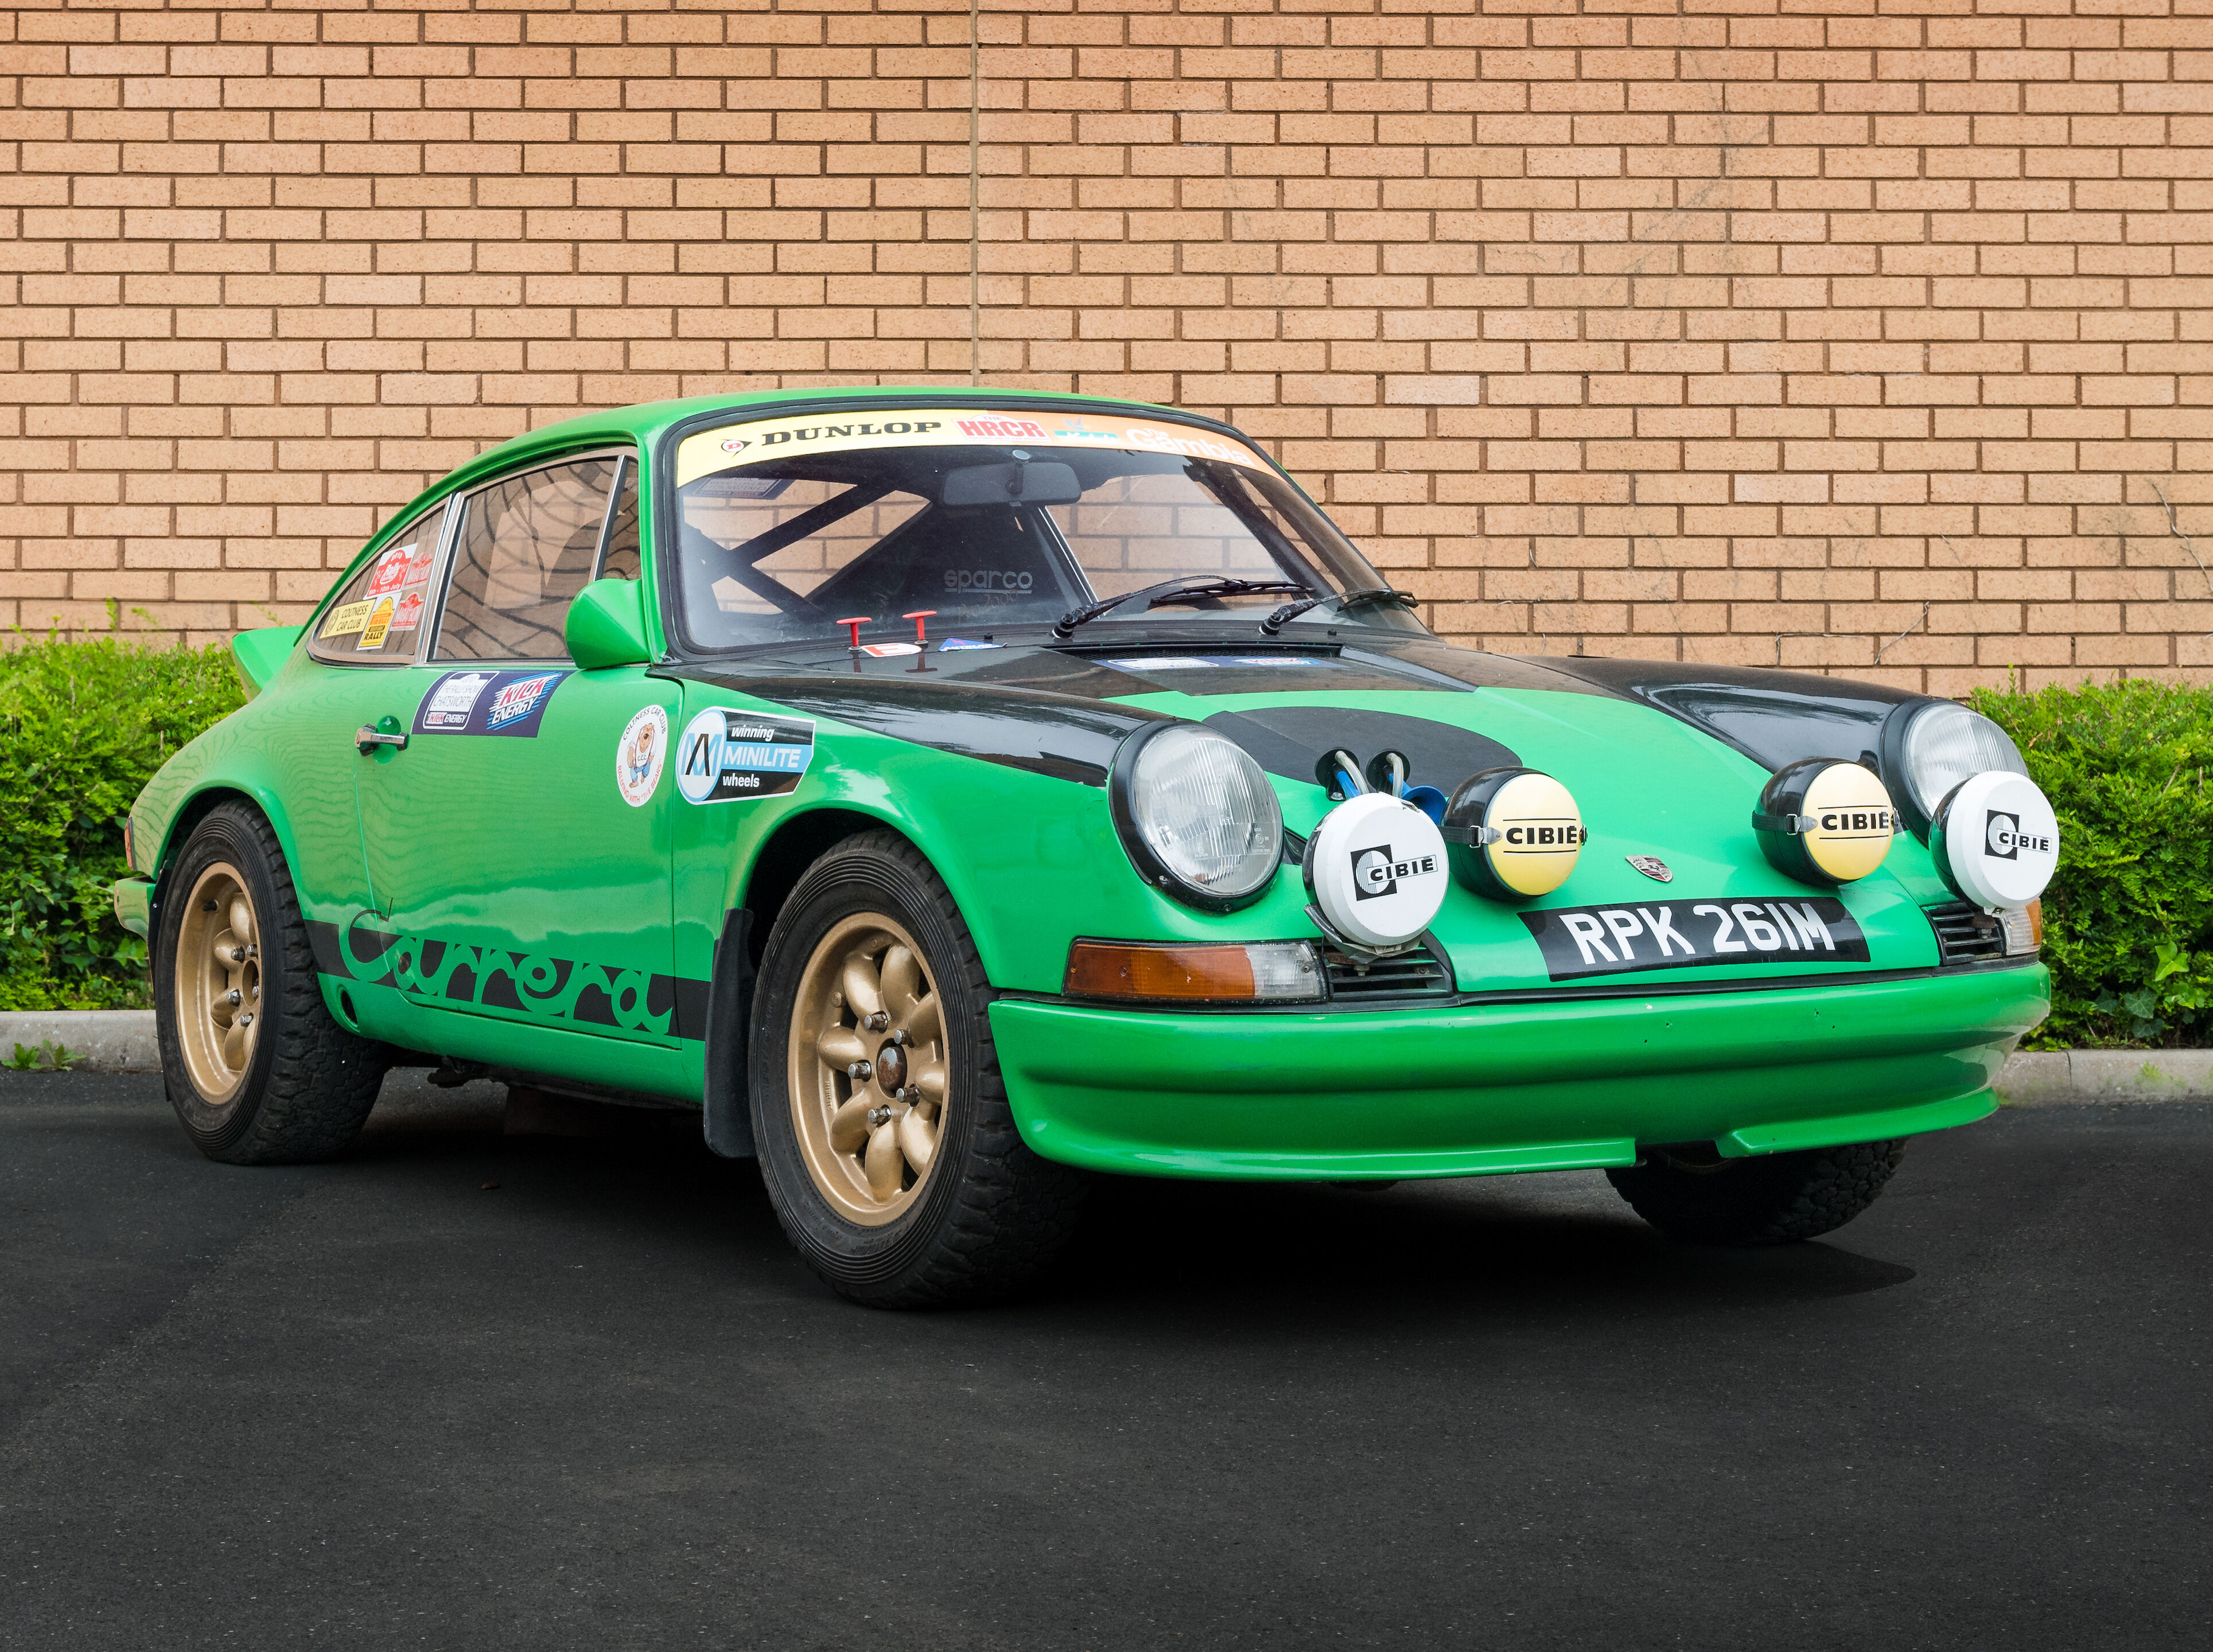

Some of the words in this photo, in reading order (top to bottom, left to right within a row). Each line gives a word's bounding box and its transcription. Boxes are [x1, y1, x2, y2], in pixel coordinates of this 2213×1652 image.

[761, 422, 942, 446] DUNLOP
[957, 420, 1046, 438] HRCR
[1144, 428, 1170, 438] The
[1126, 428, 1257, 468] Gambia
[944, 569, 1033, 594] sparco
[341, 605, 368, 619] COLTNESS
[336, 621, 348, 632] CAR
[347, 618, 362, 630] CLUB
[364, 632, 384, 641] RALLY
[433, 695, 475, 707] CHATSWORTH
[499, 677, 550, 707] KICK
[429, 713, 445, 723] KICK
[444, 714, 467, 724] ENERGY
[491, 696, 539, 725] ENERGY
[623, 707, 651, 740] COLTNESS
[651, 707, 661, 716] CAR
[730, 724, 775, 742] winning
[724, 746, 802, 768] MINILITE
[722, 773, 760, 788] wheels
[1558, 906, 1696, 965] RPK
[1693, 903, 1836, 953] 261M
[339, 898, 673, 1035] Carrera
